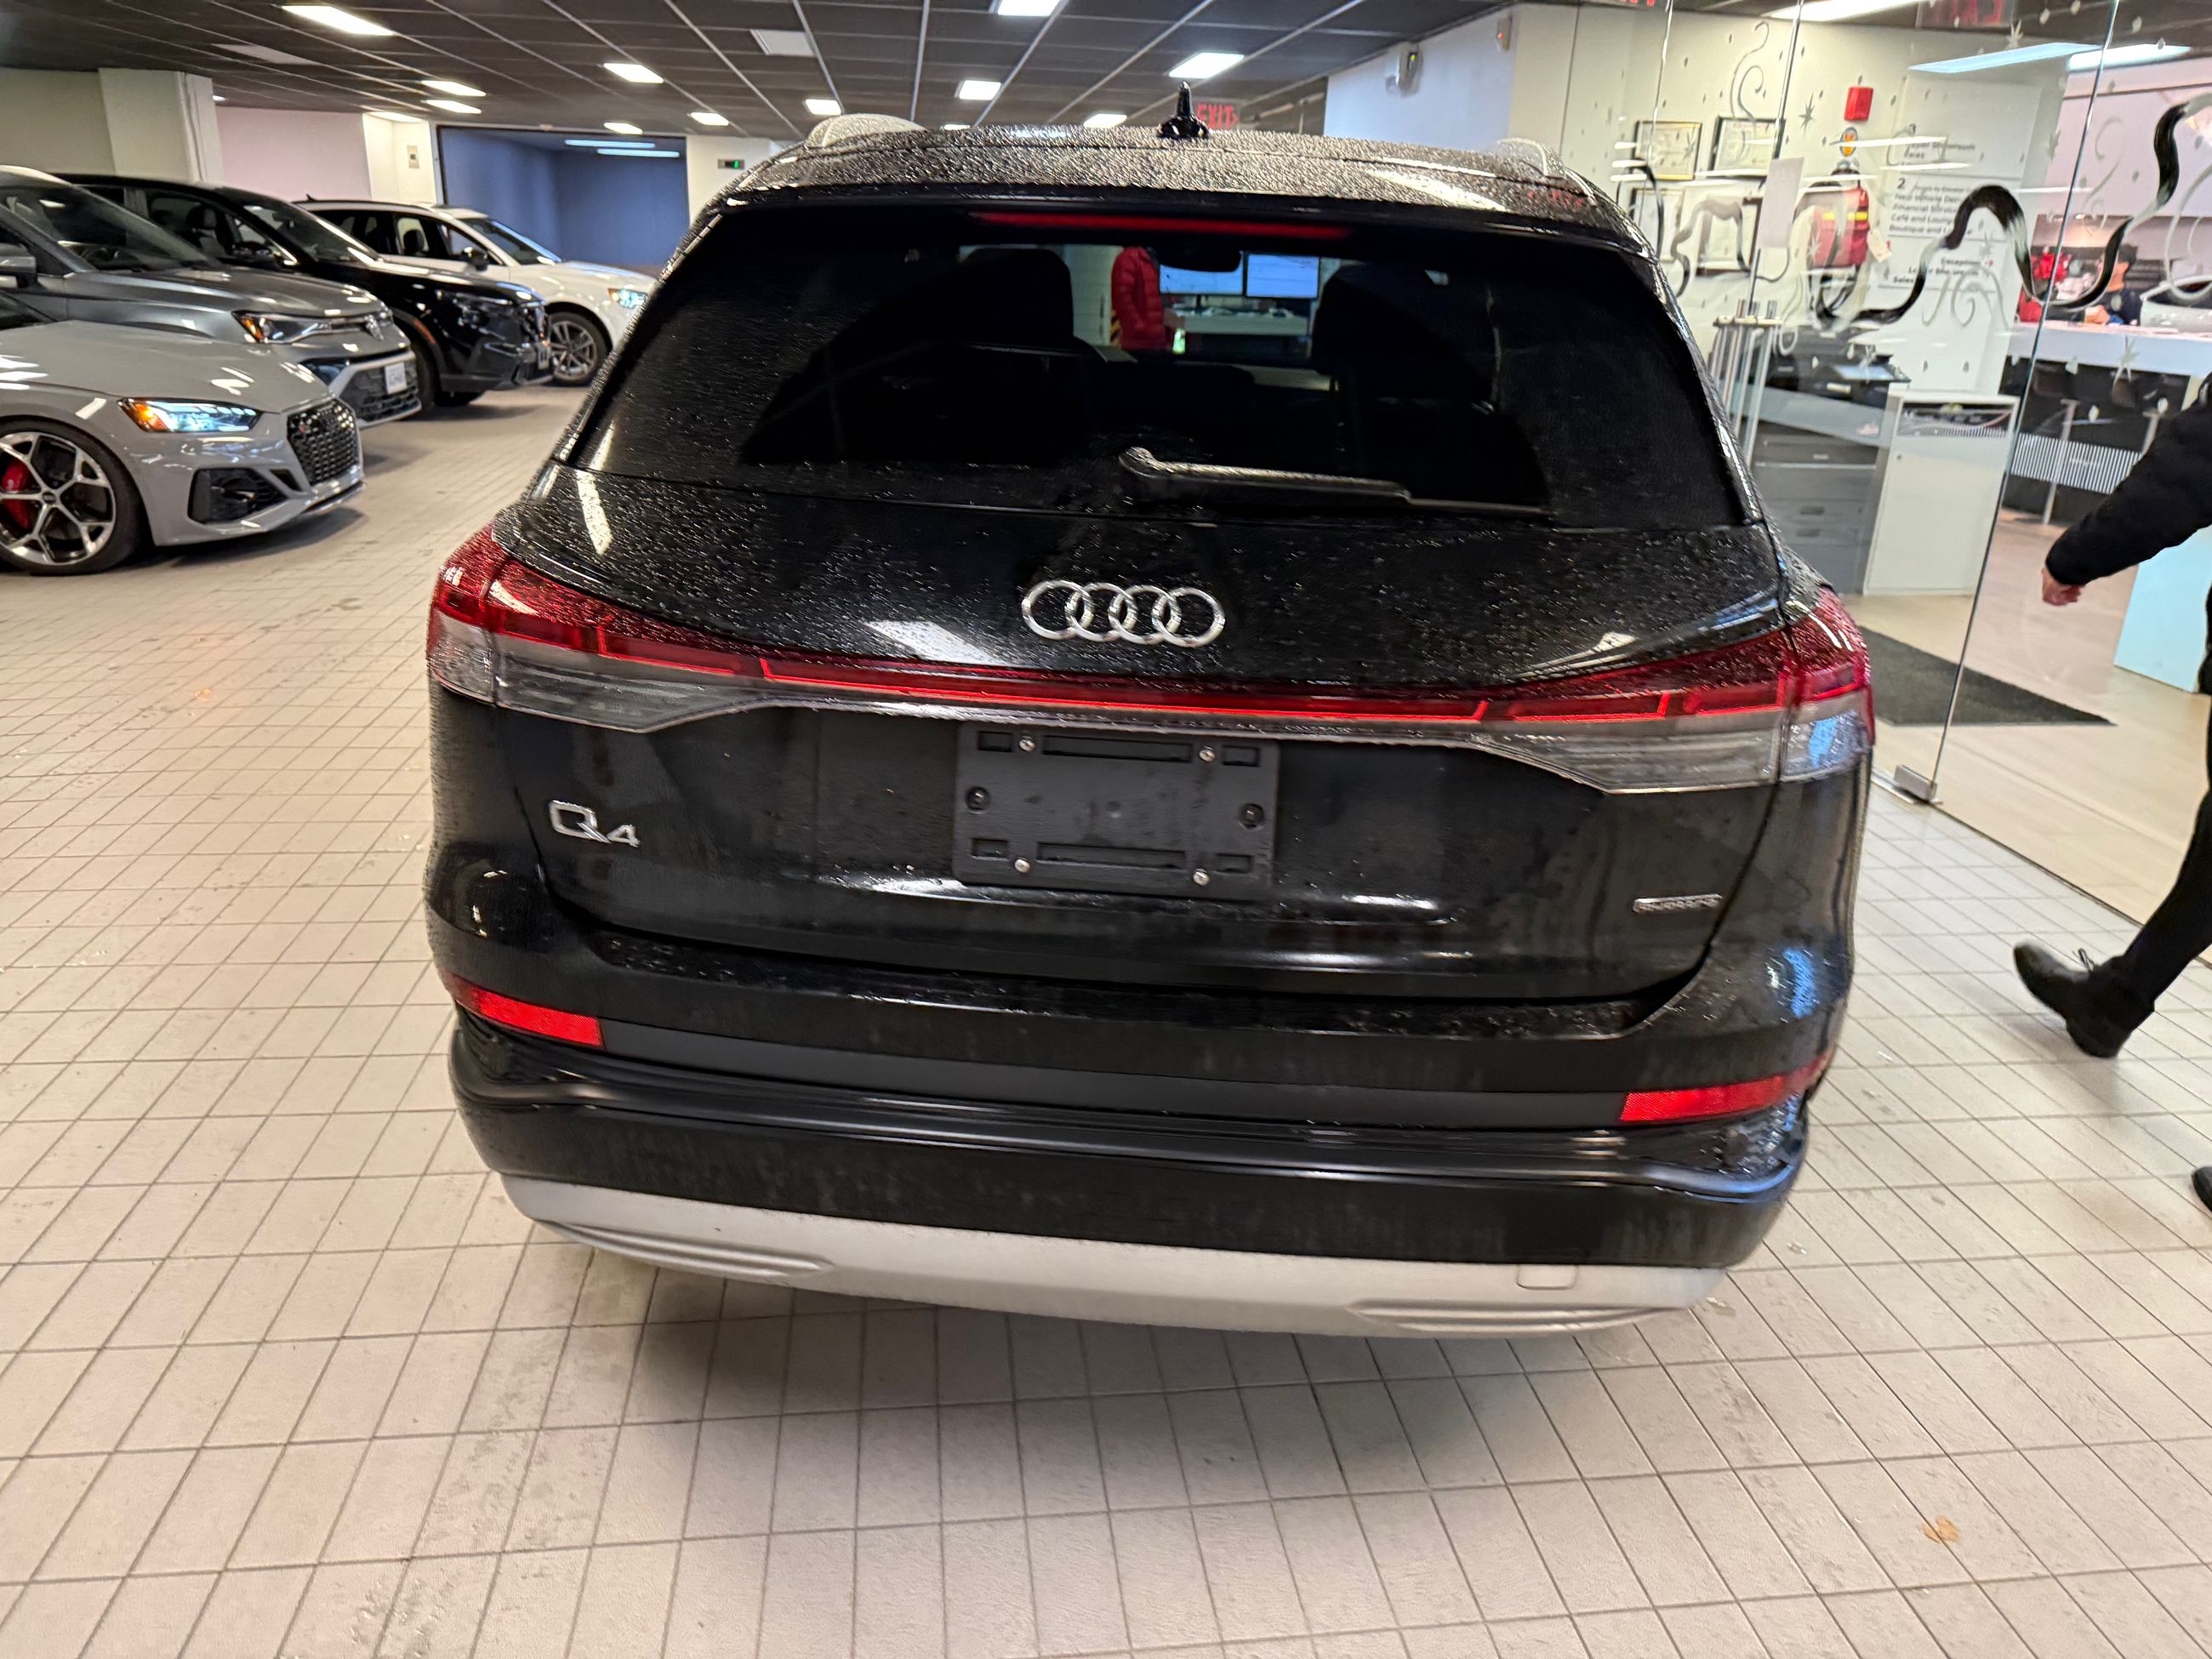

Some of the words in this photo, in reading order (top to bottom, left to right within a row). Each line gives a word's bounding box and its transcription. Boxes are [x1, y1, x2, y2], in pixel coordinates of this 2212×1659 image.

[1197, 102, 1234, 129] EXIT
[1897, 177, 1906, 189] 2
[549, 800, 641, 847] Q4
